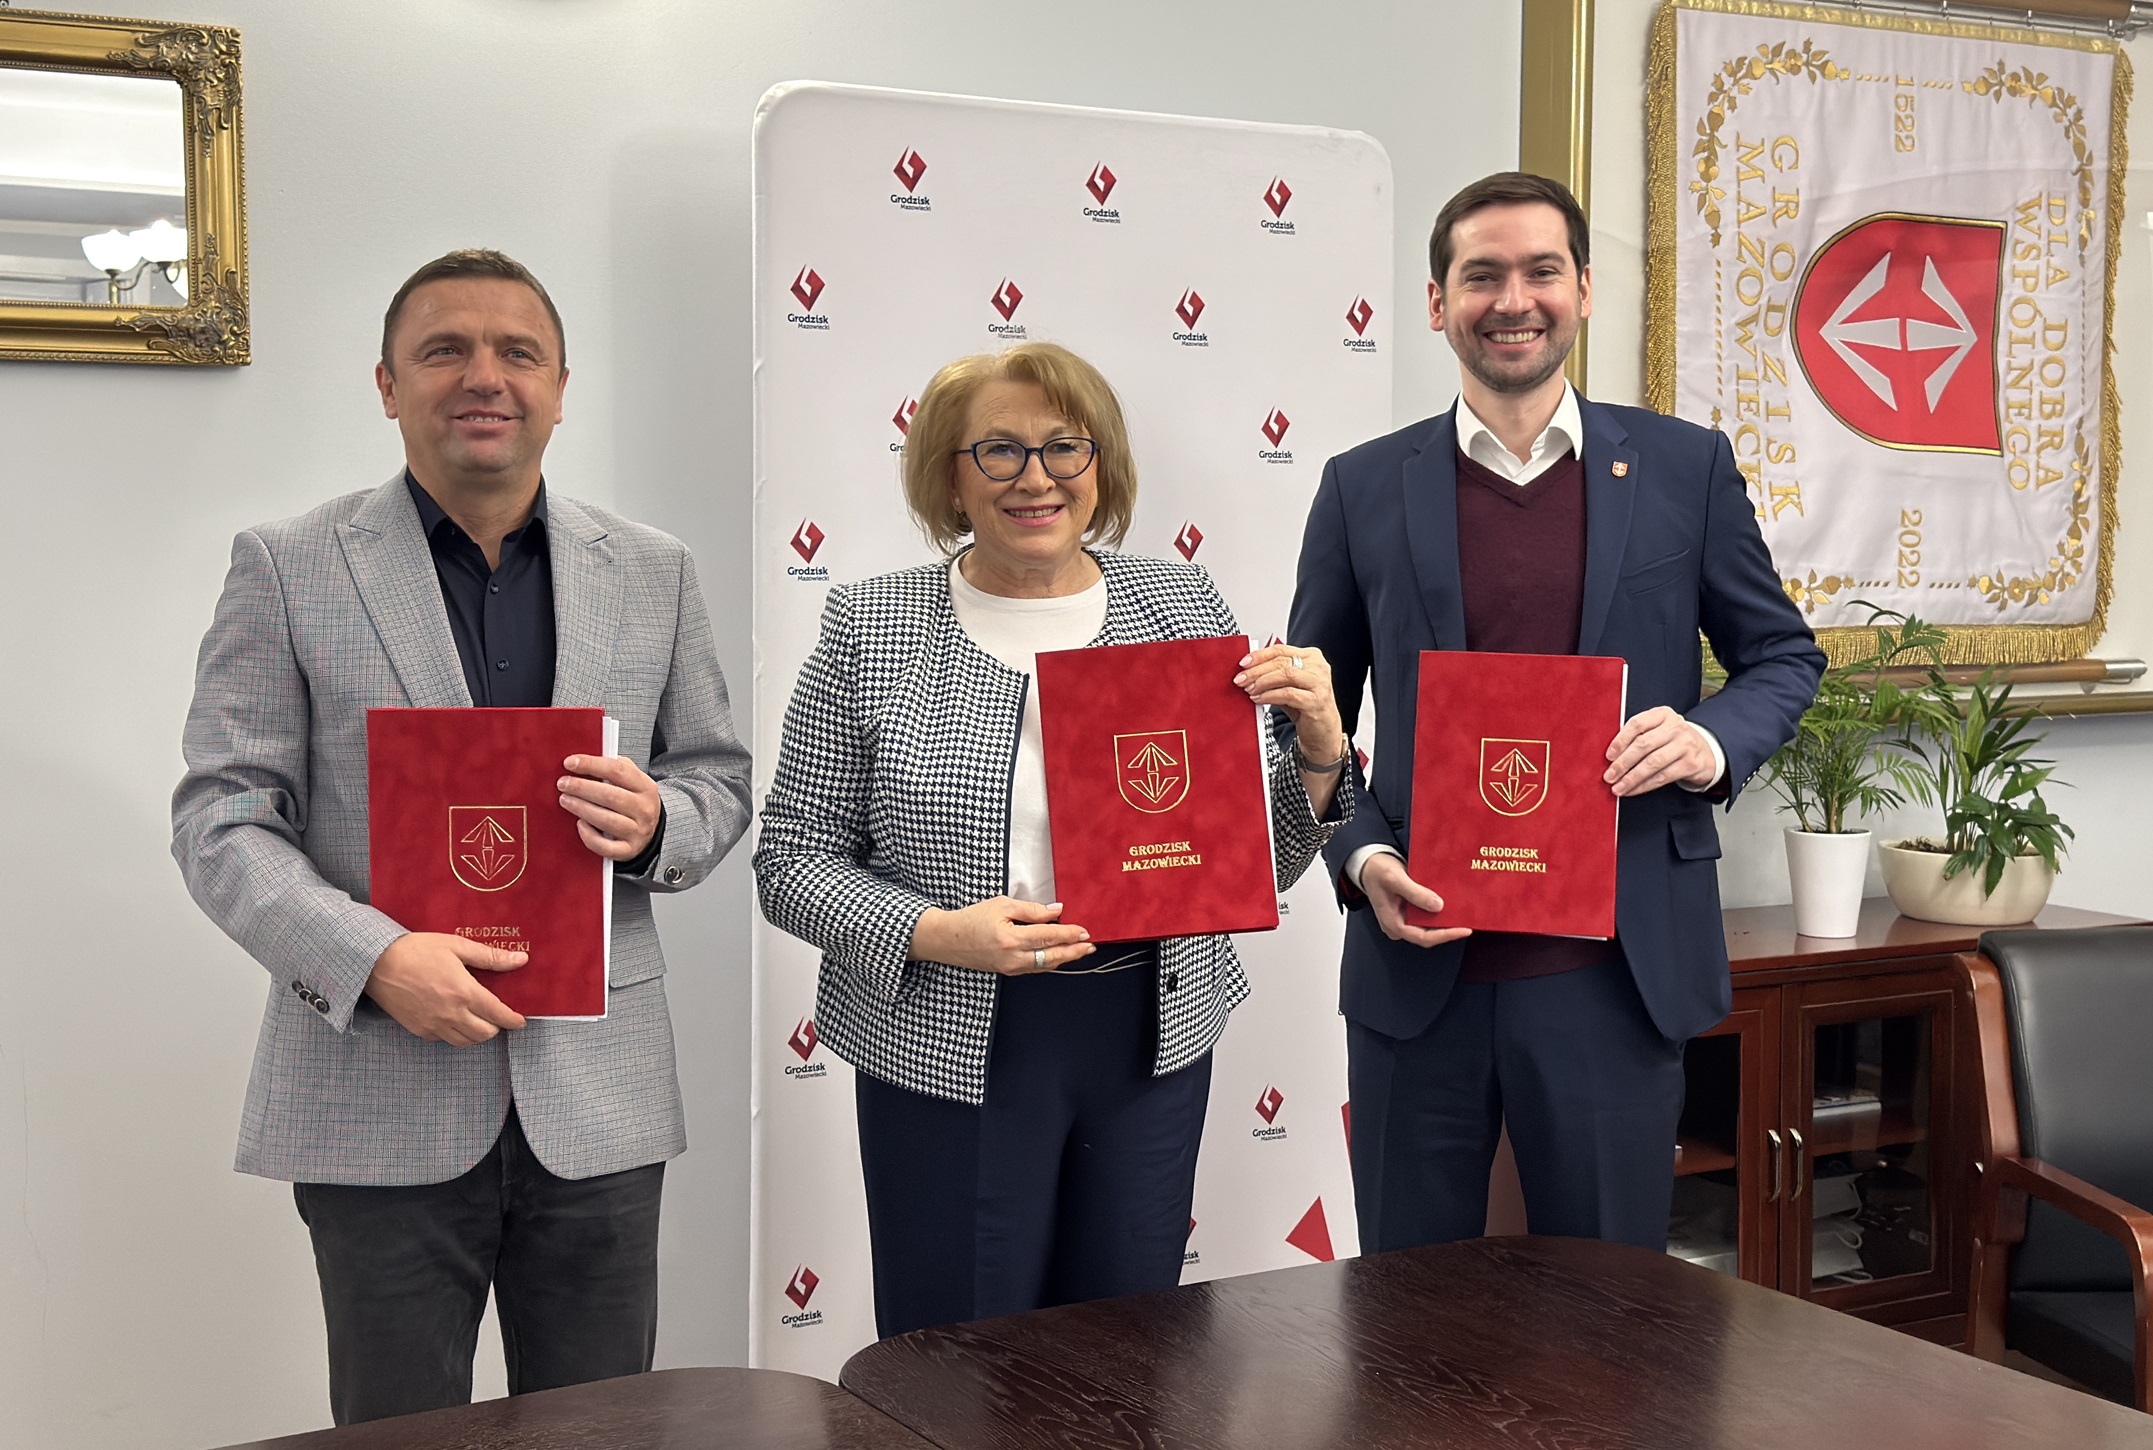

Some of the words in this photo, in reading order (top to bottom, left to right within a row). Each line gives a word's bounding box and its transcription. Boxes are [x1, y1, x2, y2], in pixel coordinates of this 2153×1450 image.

[1894, 74, 1915, 153] 1522
[890, 194, 930, 205] Grodzisk
[1083, 207, 1120, 218] Grodzisk
[1092, 216, 1121, 224] Mazowiecki
[1260, 220, 1294, 230] Grodzisk
[2046, 194, 2070, 290] DLA
[787, 313, 829, 324] Grodzisk
[798, 323, 830, 331] Mazowiecki
[988, 324, 1026, 334] Grodzisk
[1762, 135, 1804, 522] GRODZISK
[1172, 332, 1208, 341] Grodzisk
[2005, 191, 2043, 491] WSPÓLNEGO
[1343, 338, 1376, 348] Grodzisk
[2035, 317, 2069, 491] DOBRA
[1259, 450, 1293, 459] Grodzisk
[1897, 508, 1922, 588] 2022
[787, 566, 829, 576] Grodzisk
[1128, 841, 1192, 857] GRODZISK
[1479, 846, 1539, 859] GRODZISK
[1121, 854, 1202, 872] MAZOWIECKI
[1470, 859, 1547, 873] MAZOWIECKI
[454, 926, 521, 938] GRODZISK
[785, 1063, 826, 1075] Grodzisk
[1252, 1126, 1286, 1137] Grodzisk
[781, 1310, 822, 1325] Grodzisk
